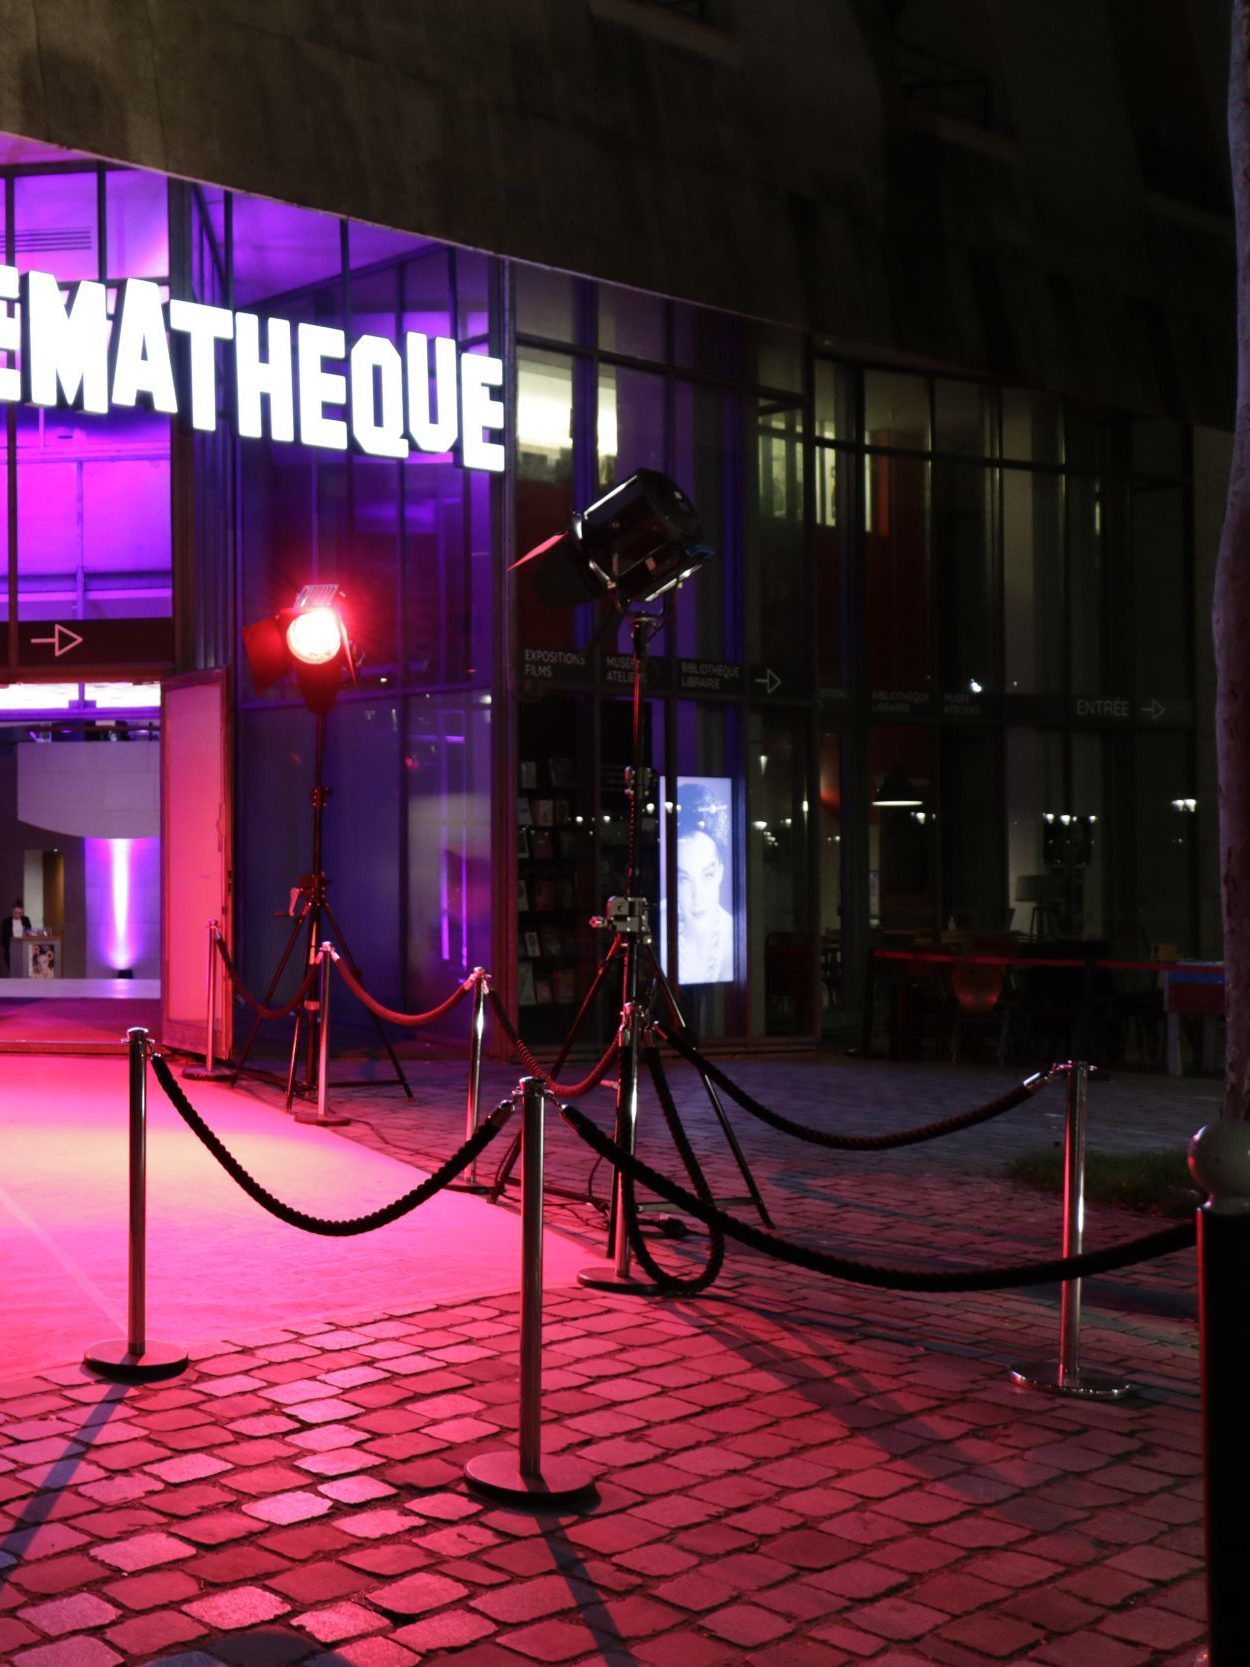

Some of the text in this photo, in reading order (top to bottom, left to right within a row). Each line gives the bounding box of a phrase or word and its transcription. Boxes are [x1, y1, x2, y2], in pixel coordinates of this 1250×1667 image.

[524, 648, 586, 666] EXPOSITIONS
[524, 663, 553, 678] FILMS
[681, 675, 721, 689] LIBRAIRIE
[1076, 696, 1130, 717] ENTRÉE
